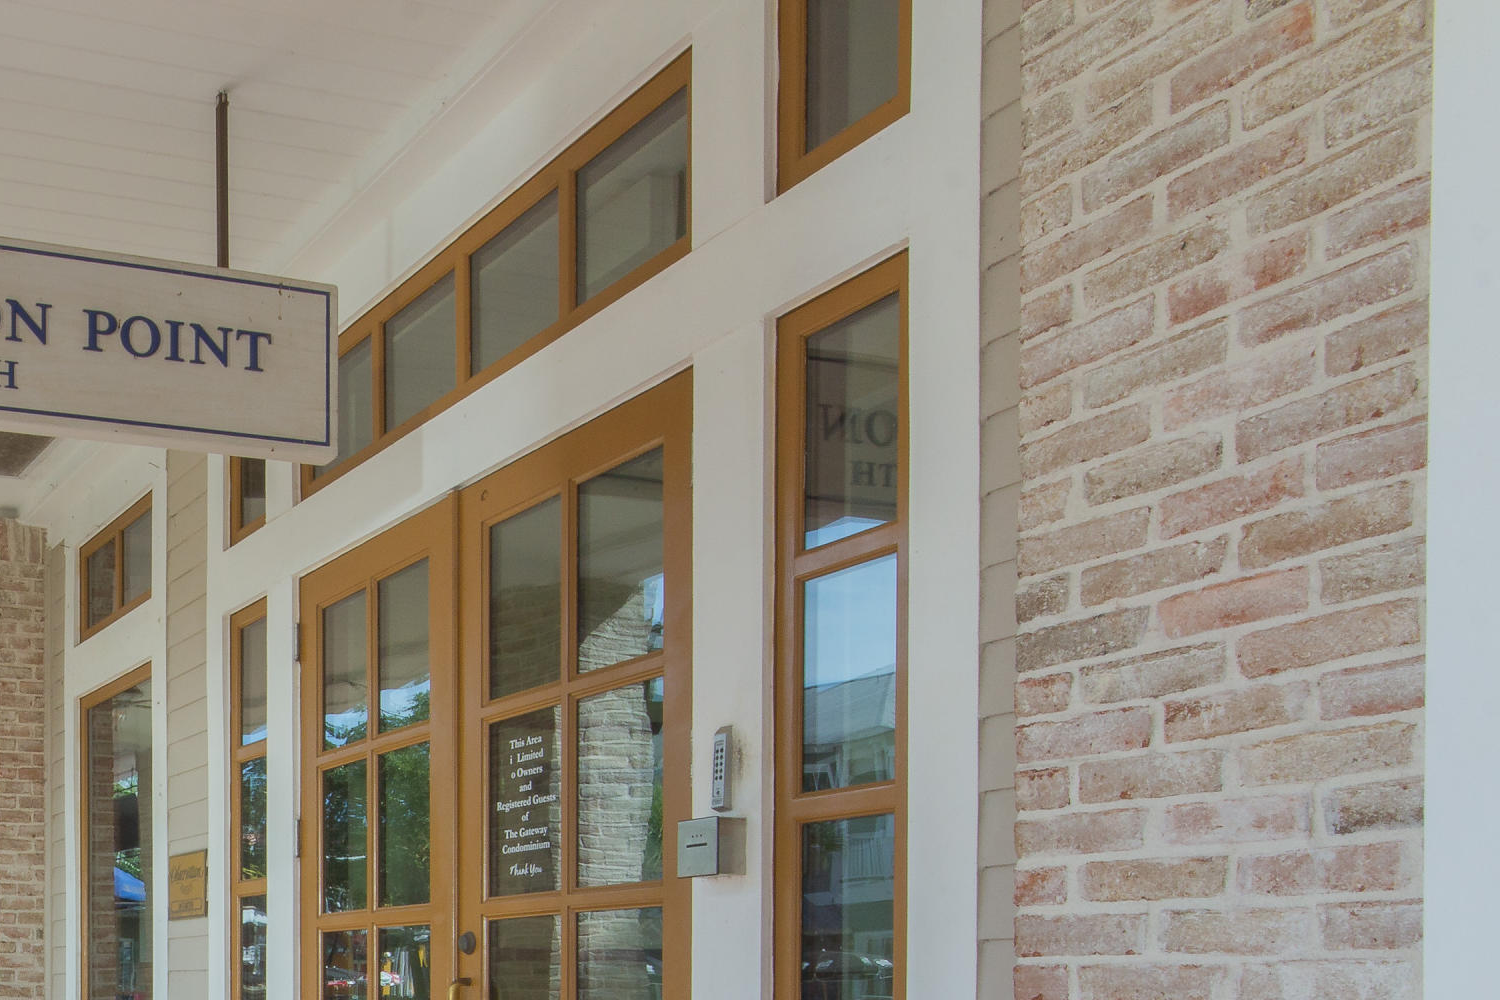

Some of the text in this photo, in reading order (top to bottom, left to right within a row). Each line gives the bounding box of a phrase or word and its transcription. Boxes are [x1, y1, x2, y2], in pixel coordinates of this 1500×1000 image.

[82, 309, 273, 373] POINT
[509, 735, 543, 750] This Area
[517, 747, 544, 763] Limited
[517, 765, 543, 778] Owners
[519, 780, 532, 793] and
[496, 793, 557, 813] Registered Guests
[521, 811, 530, 822] of
[504, 826, 548, 840] The Gateway
[502, 840, 551, 855] Condominium
[509, 862, 543, 878] Thank You
